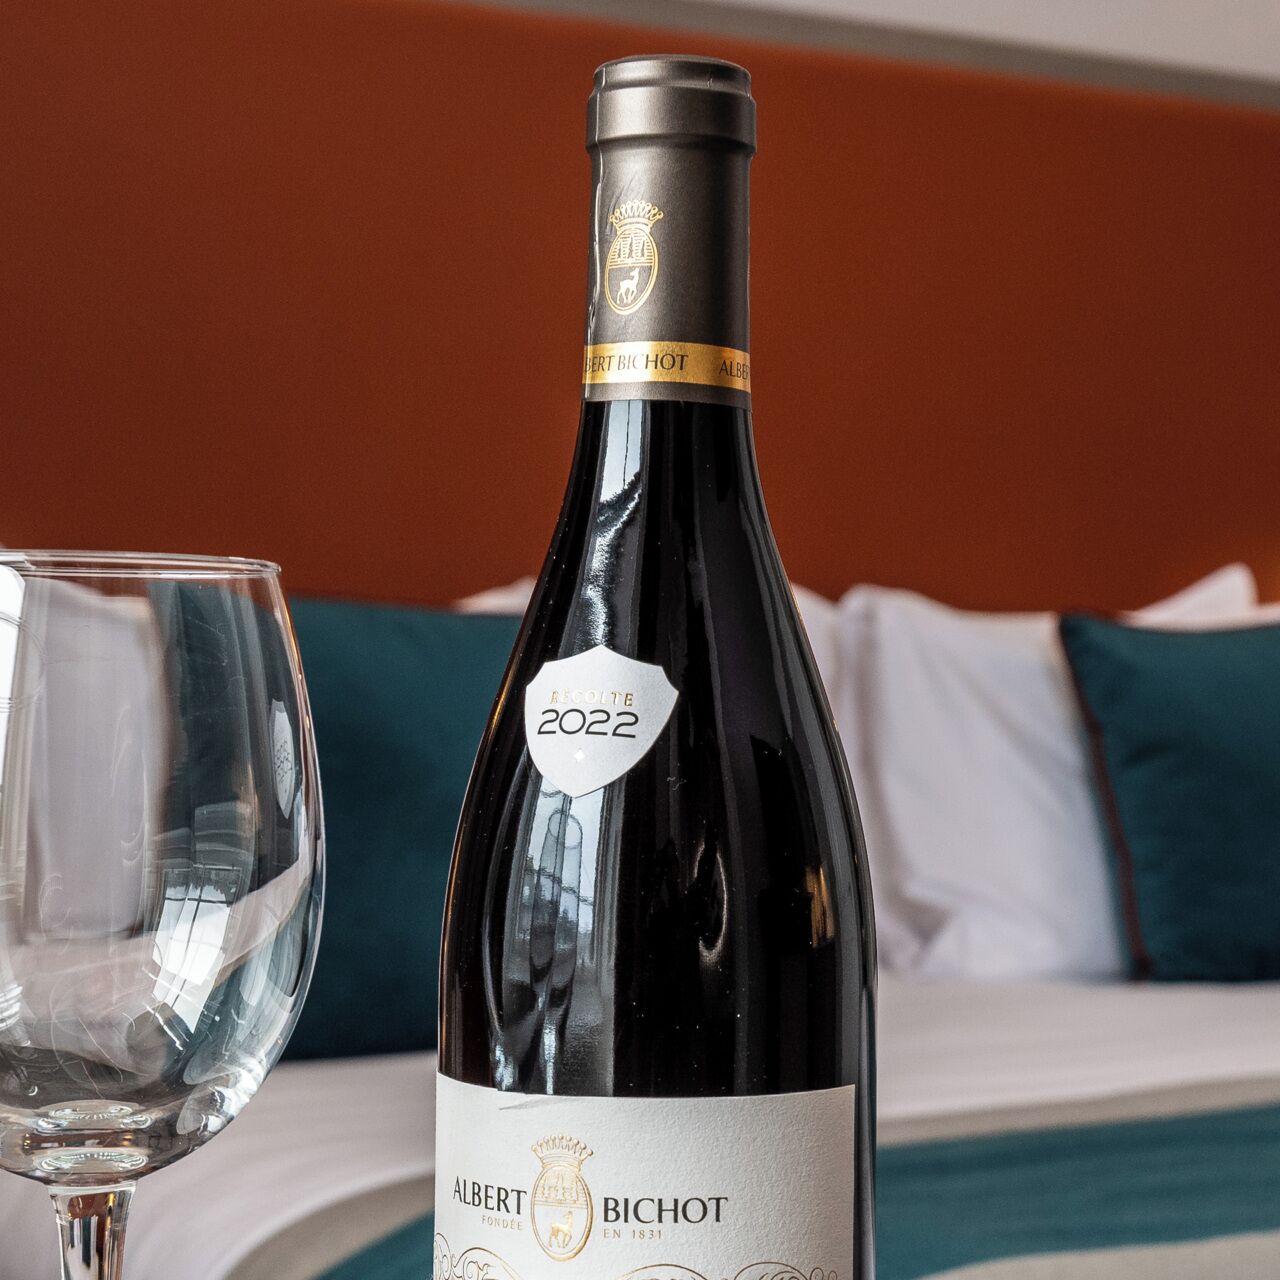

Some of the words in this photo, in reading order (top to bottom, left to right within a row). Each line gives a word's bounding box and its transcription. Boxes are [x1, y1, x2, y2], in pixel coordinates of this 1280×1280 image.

[617, 353, 688, 371] BICHOT
[537, 708, 639, 739] 2022
[453, 1176, 527, 1216] ALBERT
[603, 1197, 729, 1224] BICHOT
[481, 1215, 524, 1231] FONDÉE
[603, 1228, 621, 1239] EN
[632, 1229, 663, 1240] 1831
